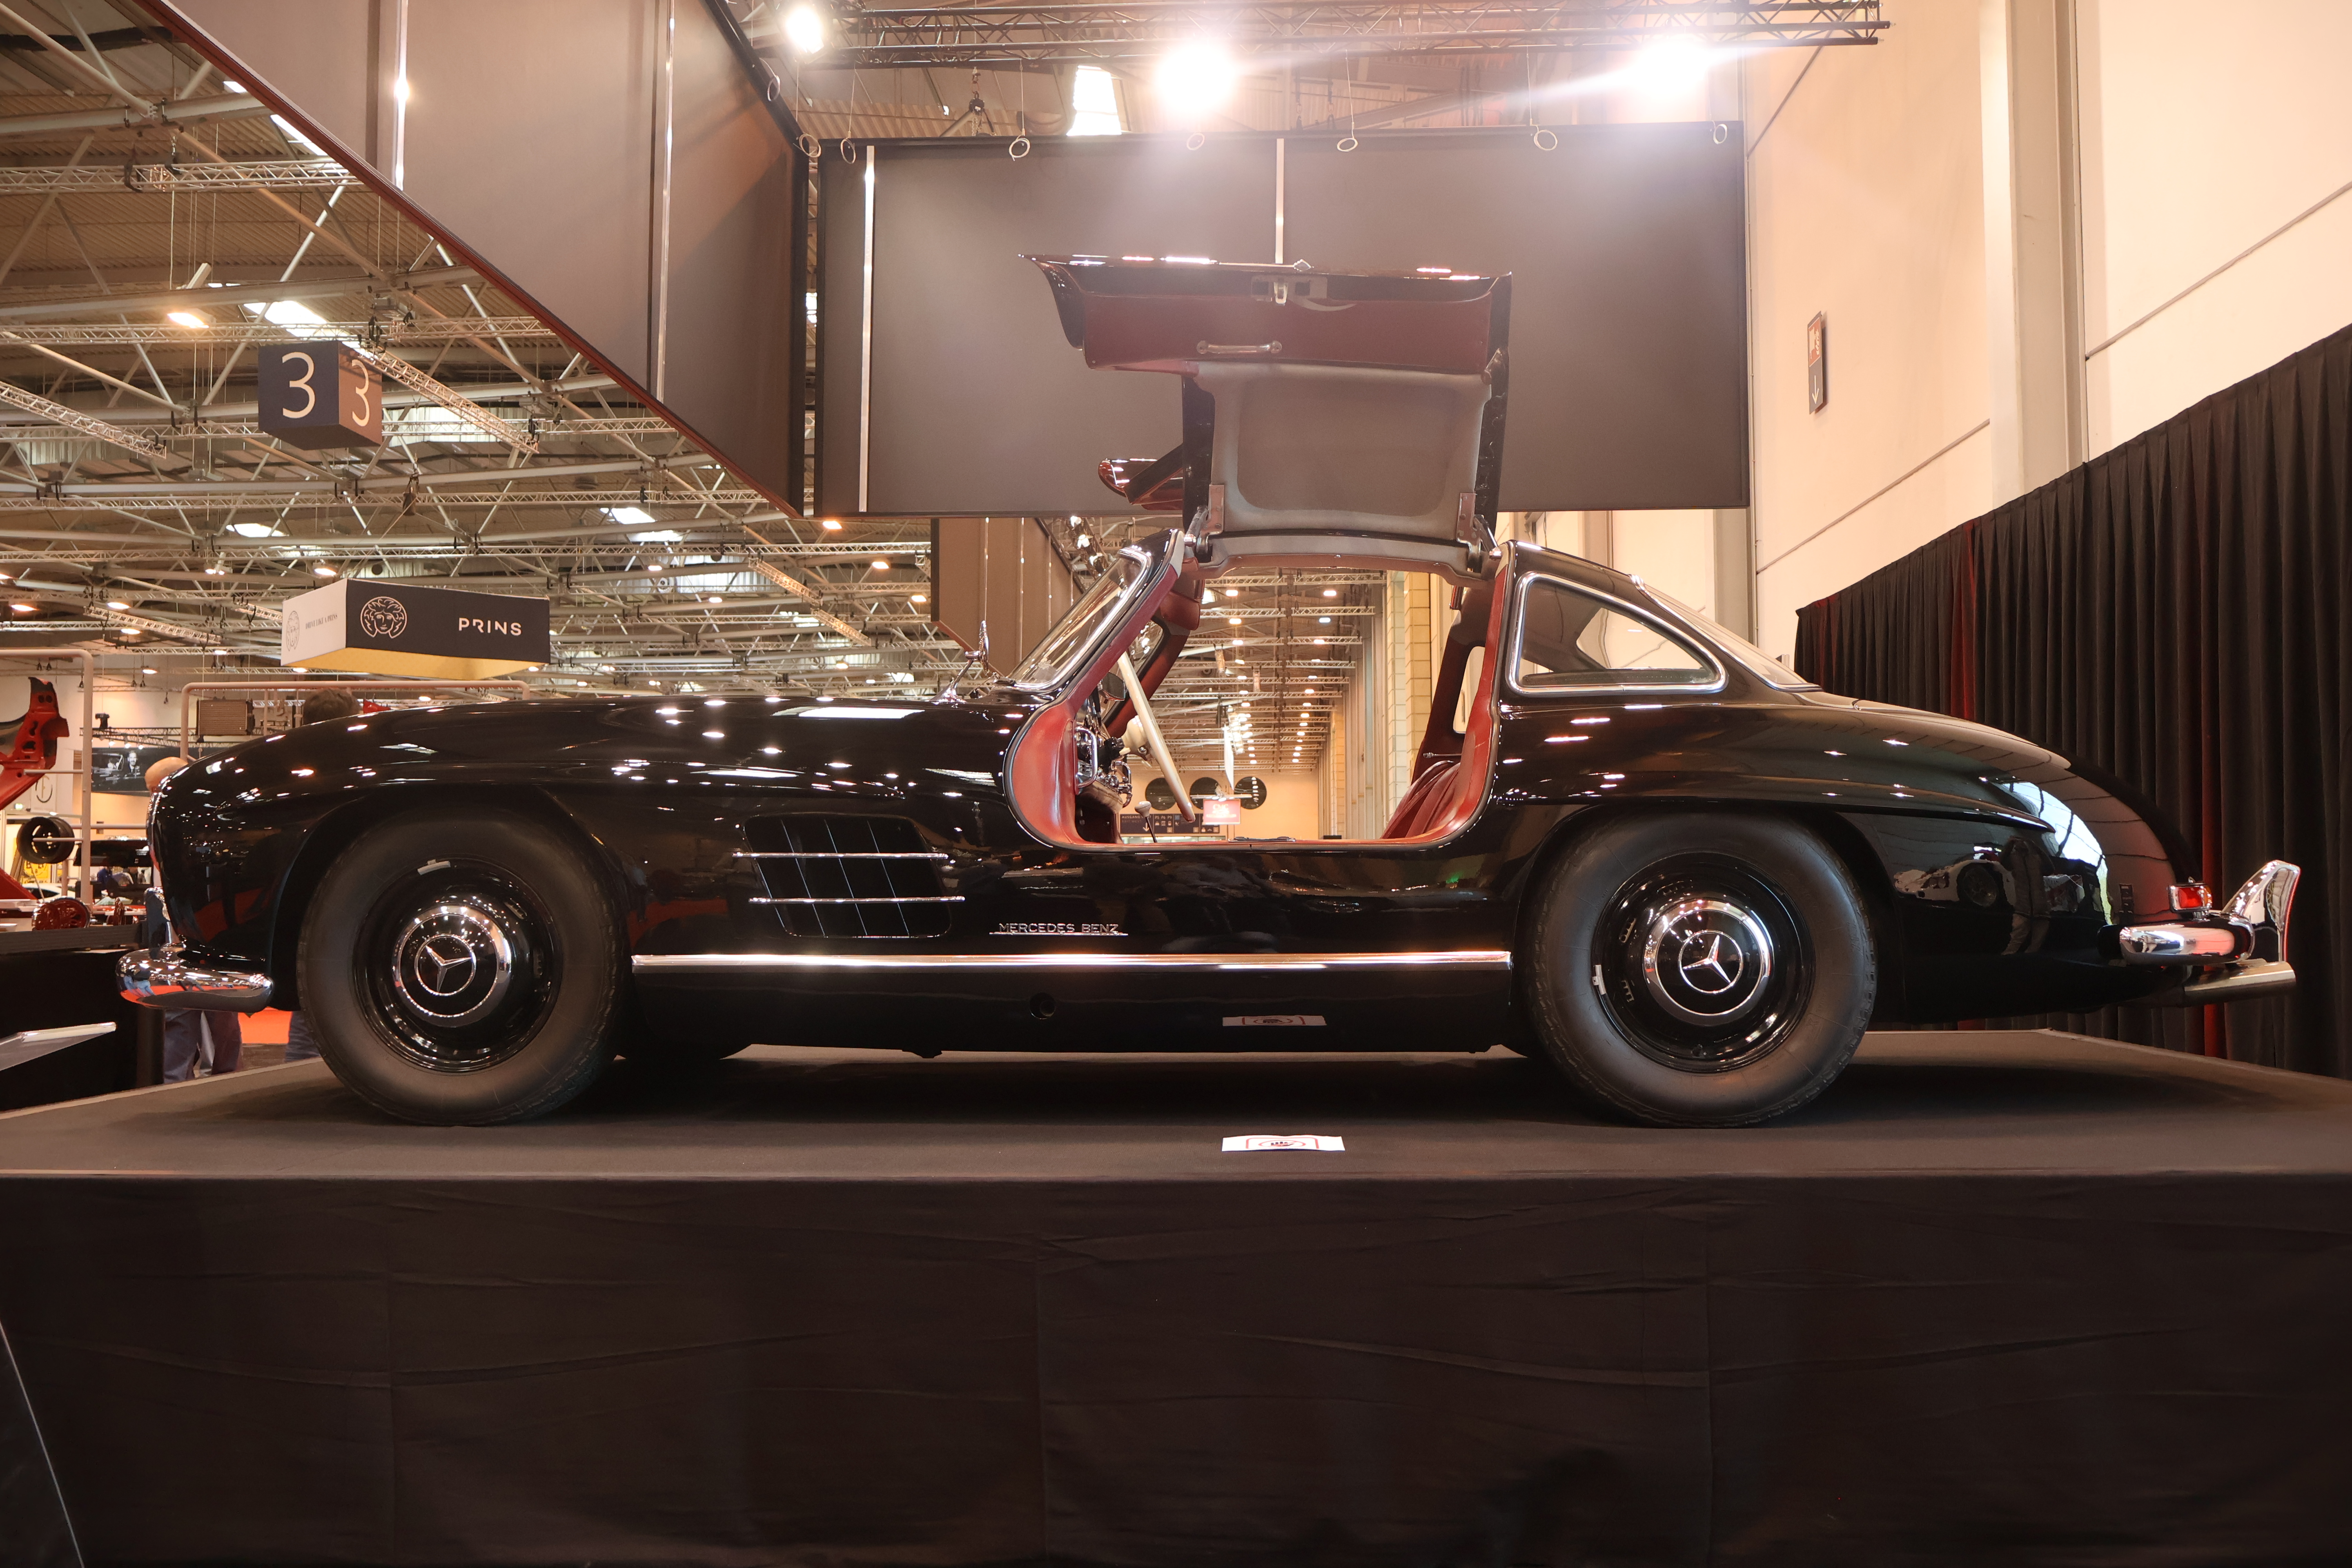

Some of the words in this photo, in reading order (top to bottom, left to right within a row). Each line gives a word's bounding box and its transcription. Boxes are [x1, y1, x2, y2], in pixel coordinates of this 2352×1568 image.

[282, 352, 315, 419] 3
[352, 359, 370, 426] 3
[305, 620, 315, 629] DRIVE
[459, 617, 522, 636] PRINS
[999, 923, 1075, 933] MERCEDES
[1082, 924, 1119, 933] BENZ
